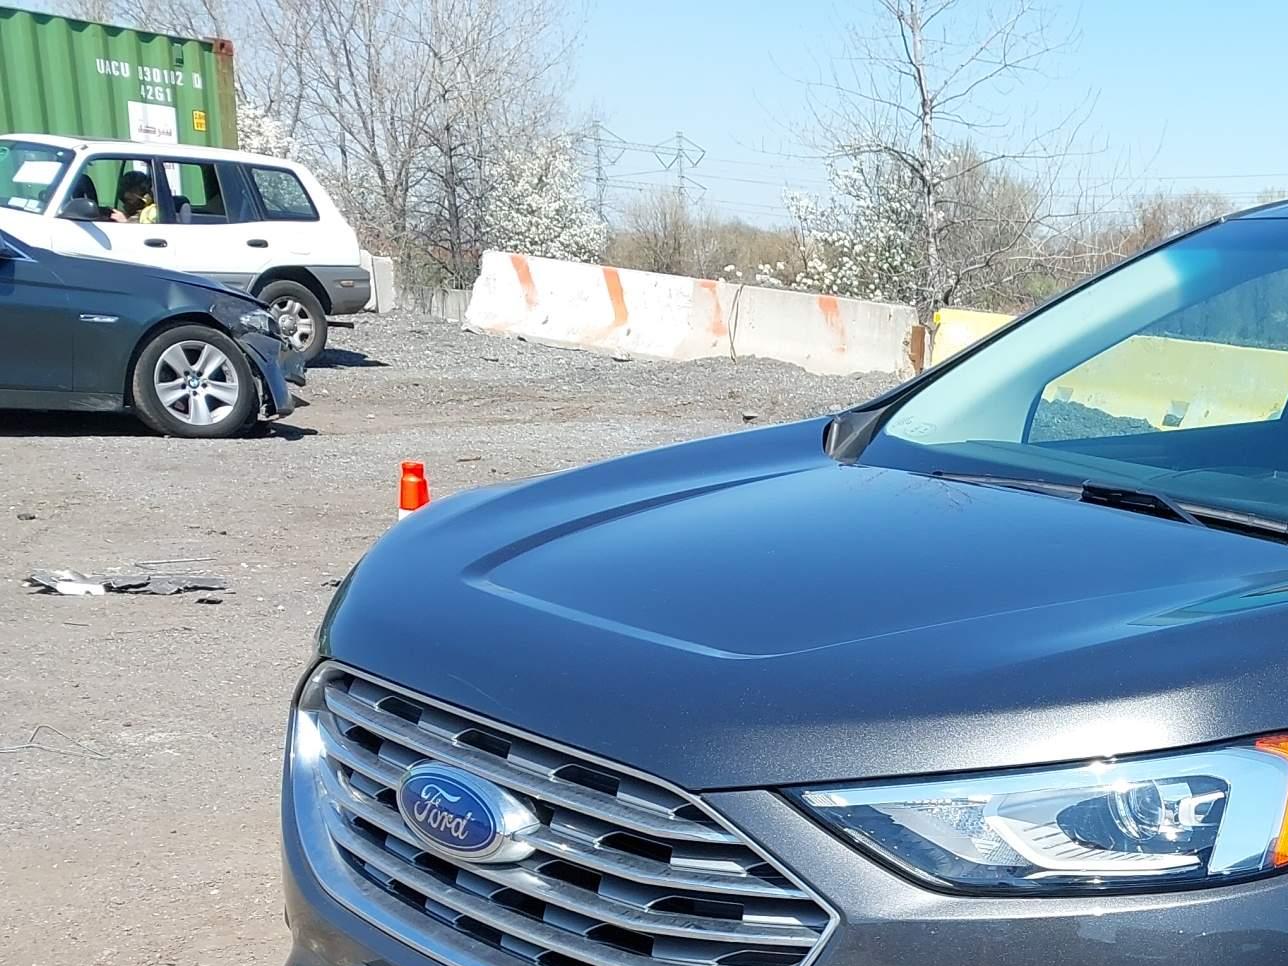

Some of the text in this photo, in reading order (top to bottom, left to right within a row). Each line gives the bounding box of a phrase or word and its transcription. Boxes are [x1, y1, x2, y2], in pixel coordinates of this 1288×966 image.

[96, 58, 130, 78] UACU
[141, 84, 173, 102] 42G1
[414, 783, 475, 840] Ford
